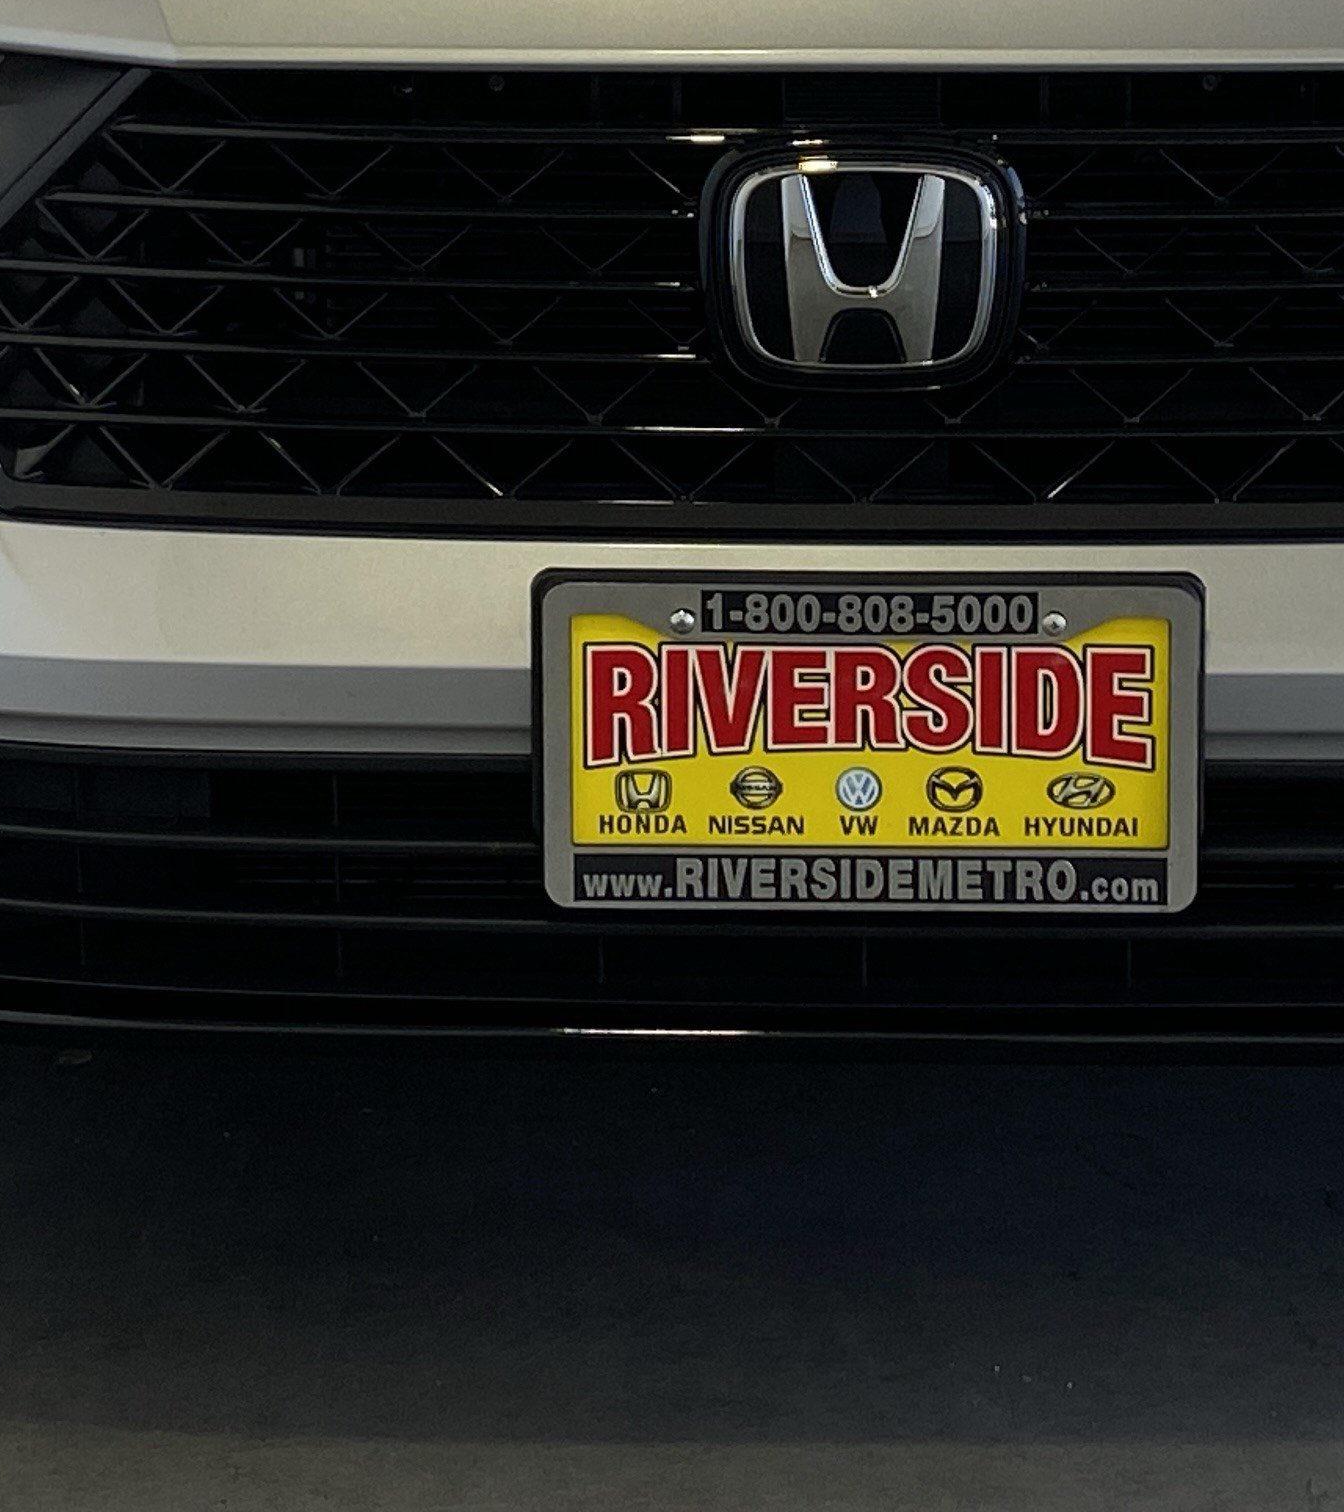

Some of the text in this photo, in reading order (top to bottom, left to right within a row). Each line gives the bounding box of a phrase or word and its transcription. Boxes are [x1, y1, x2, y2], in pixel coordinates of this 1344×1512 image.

[705, 593, 1035, 633] 1-800-808-5000
[583, 641, 1155, 770] RIVERSIDE
[598, 814, 1139, 837] HONDA NISSAN VW MAZDA HYUNDAI
[582, 858, 1159, 903] www.RIVERSIDEMETRO.com
